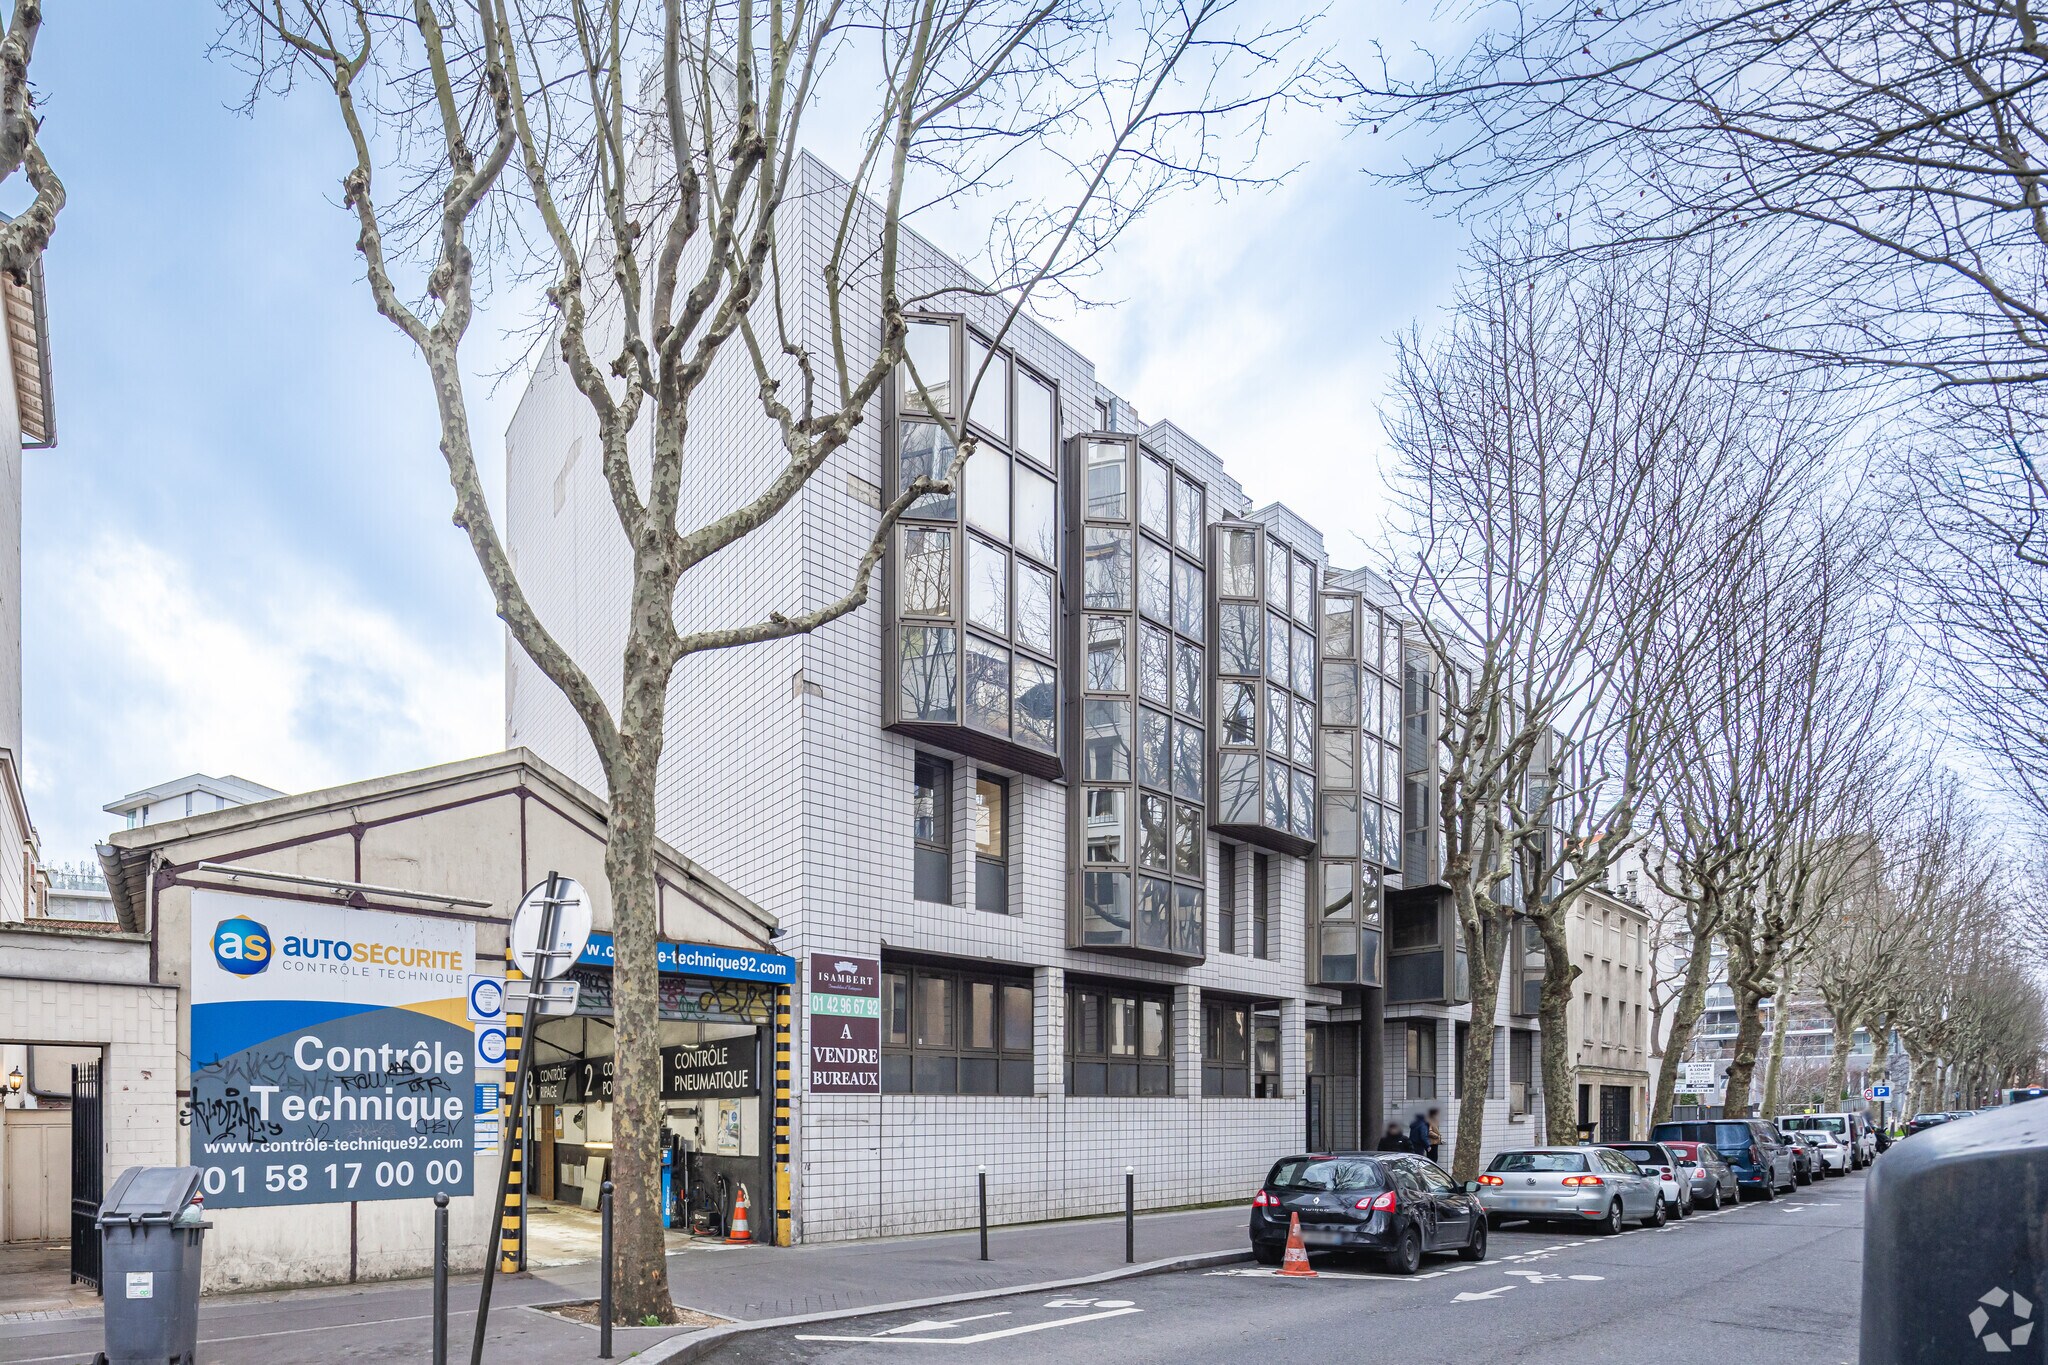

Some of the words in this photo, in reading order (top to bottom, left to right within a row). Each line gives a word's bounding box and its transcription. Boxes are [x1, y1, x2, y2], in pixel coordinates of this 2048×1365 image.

[282, 960, 370, 977] CONTRÔLE
[379, 968, 463, 984] TECHNIQUE
[818, 972, 873, 986] ISAMBERT
[812, 995, 824, 1012] 01
[827, 996, 838, 1012] 42
[841, 997, 851, 1014] 96
[854, 999, 865, 1014] 67
[867, 999, 878, 1015] 92
[840, 1023, 852, 1039] A
[294, 1035, 463, 1075] Contrôle
[674, 1044, 728, 1070] CONTRÔLE
[812, 1046, 878, 1064] VENDRE
[526, 1070, 534, 1099] 3
[540, 1065, 567, 1083] CONTRÔLE
[584, 1063, 593, 1096] 2
[674, 1069, 749, 1091] PNEUMATIQUE
[812, 1071, 878, 1086] BUREAUX
[250, 1085, 463, 1128] Technique
[204, 1136, 463, 1155] www.contrôle-technique92.com
[203, 1166, 245, 1195] 01
[265, 1164, 308, 1193] 58
[324, 1162, 363, 1190] 17
[375, 1160, 414, 1188] 00
[425, 1159, 463, 1185] 00
